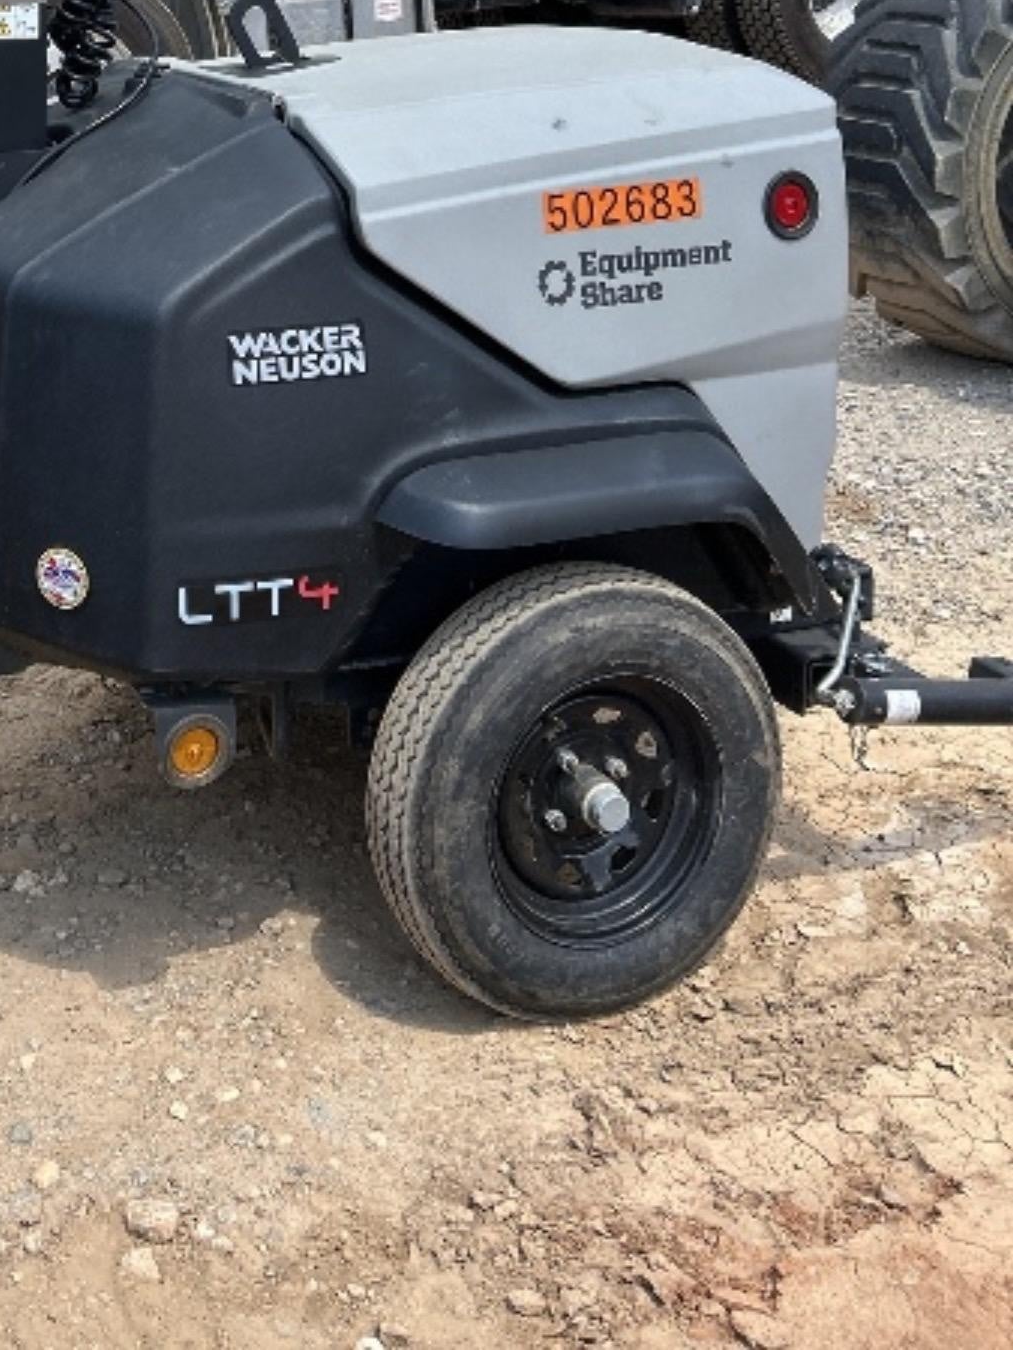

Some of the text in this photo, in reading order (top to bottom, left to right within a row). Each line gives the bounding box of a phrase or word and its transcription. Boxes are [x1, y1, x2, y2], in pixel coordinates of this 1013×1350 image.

[547, 179, 698, 232] 502683
[578, 239, 733, 279] Equipment
[580, 279, 664, 310] Share
[227, 324, 364, 358] WACKER
[231, 349, 367, 385] NEUSON
[178, 575, 340, 625] LTT4
